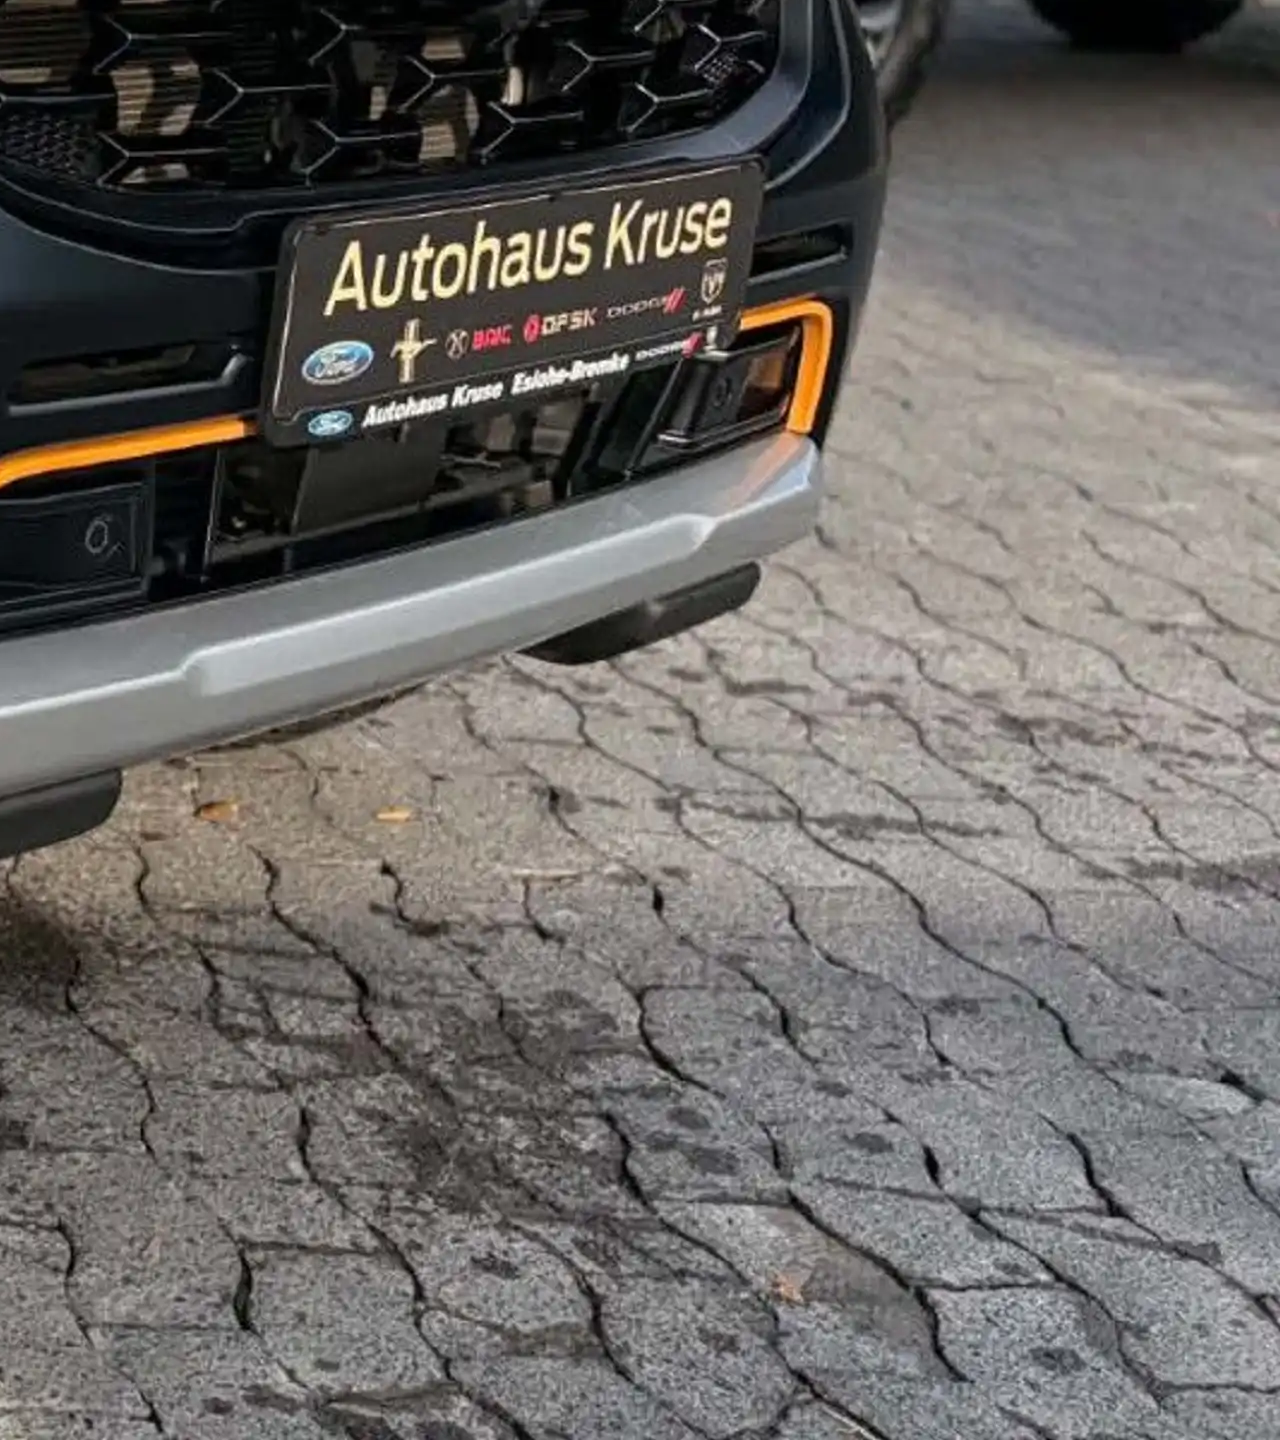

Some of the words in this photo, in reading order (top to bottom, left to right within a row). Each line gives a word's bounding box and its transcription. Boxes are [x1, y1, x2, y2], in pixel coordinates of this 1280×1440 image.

[323, 220, 595, 317] Autohaus
[603, 196, 733, 271] Kruse
[362, 392, 449, 429] Autohaus
[451, 379, 505, 410] Kruse
